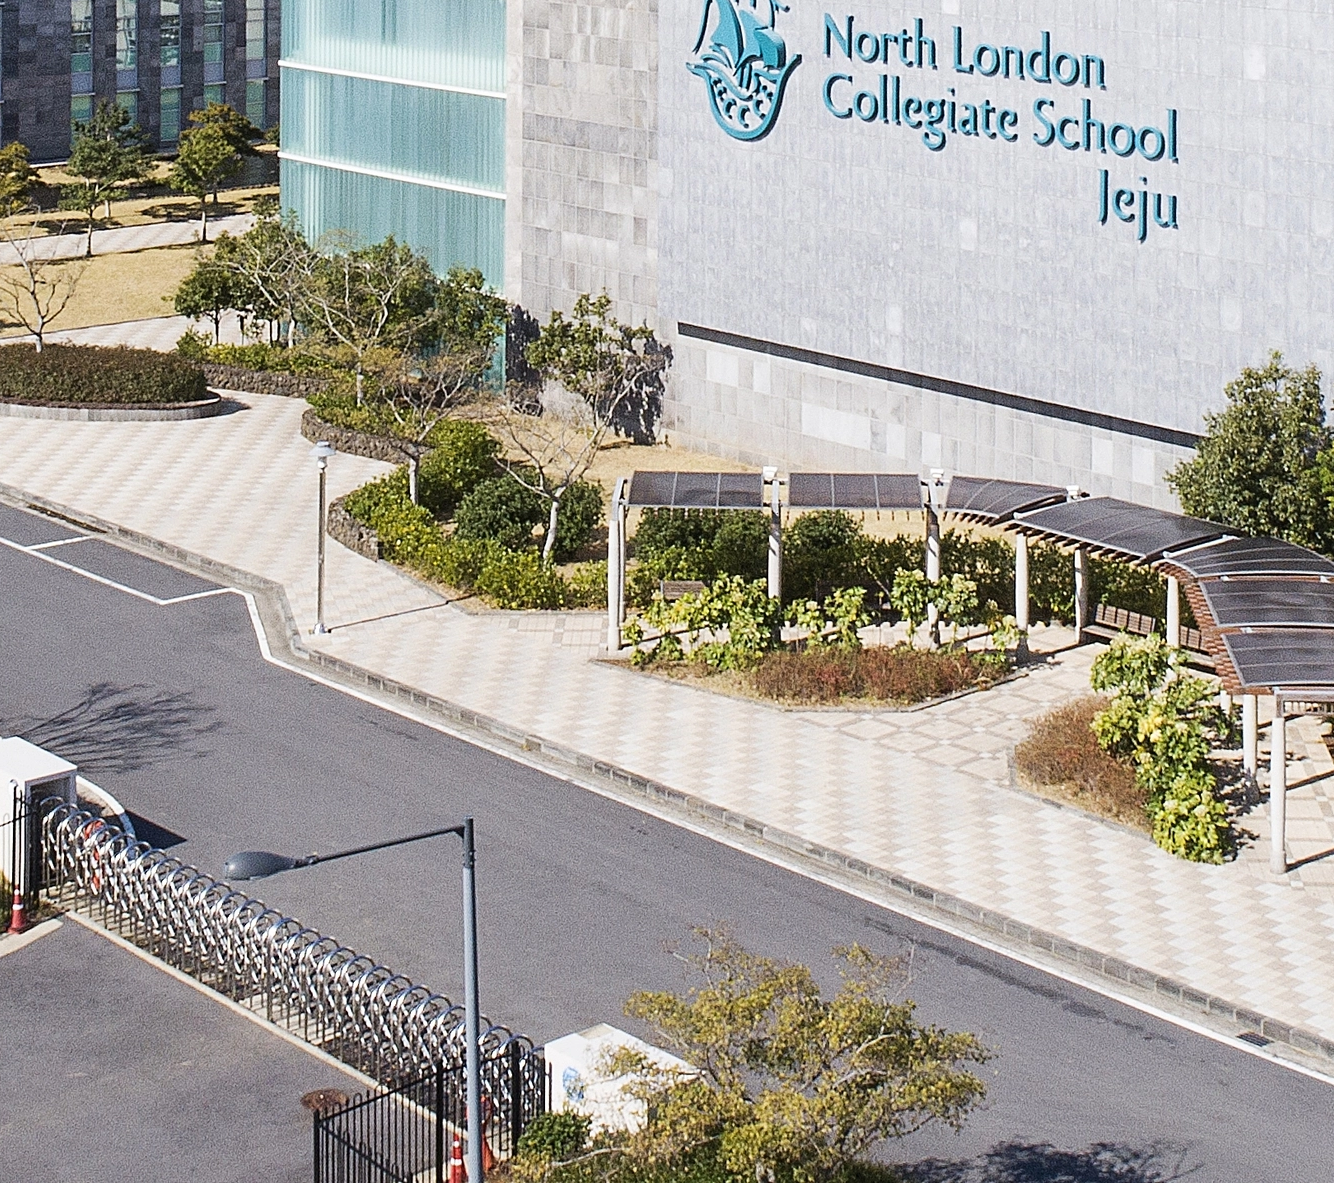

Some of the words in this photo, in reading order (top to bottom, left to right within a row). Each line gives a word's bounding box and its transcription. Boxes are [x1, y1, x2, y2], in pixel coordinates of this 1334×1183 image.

[822, 13, 937, 70] North
[953, 26, 1107, 90] London
[822, 74, 1019, 152] Collegiate
[1033, 98, 1180, 164] School
[1098, 168, 1180, 245] Jeju
